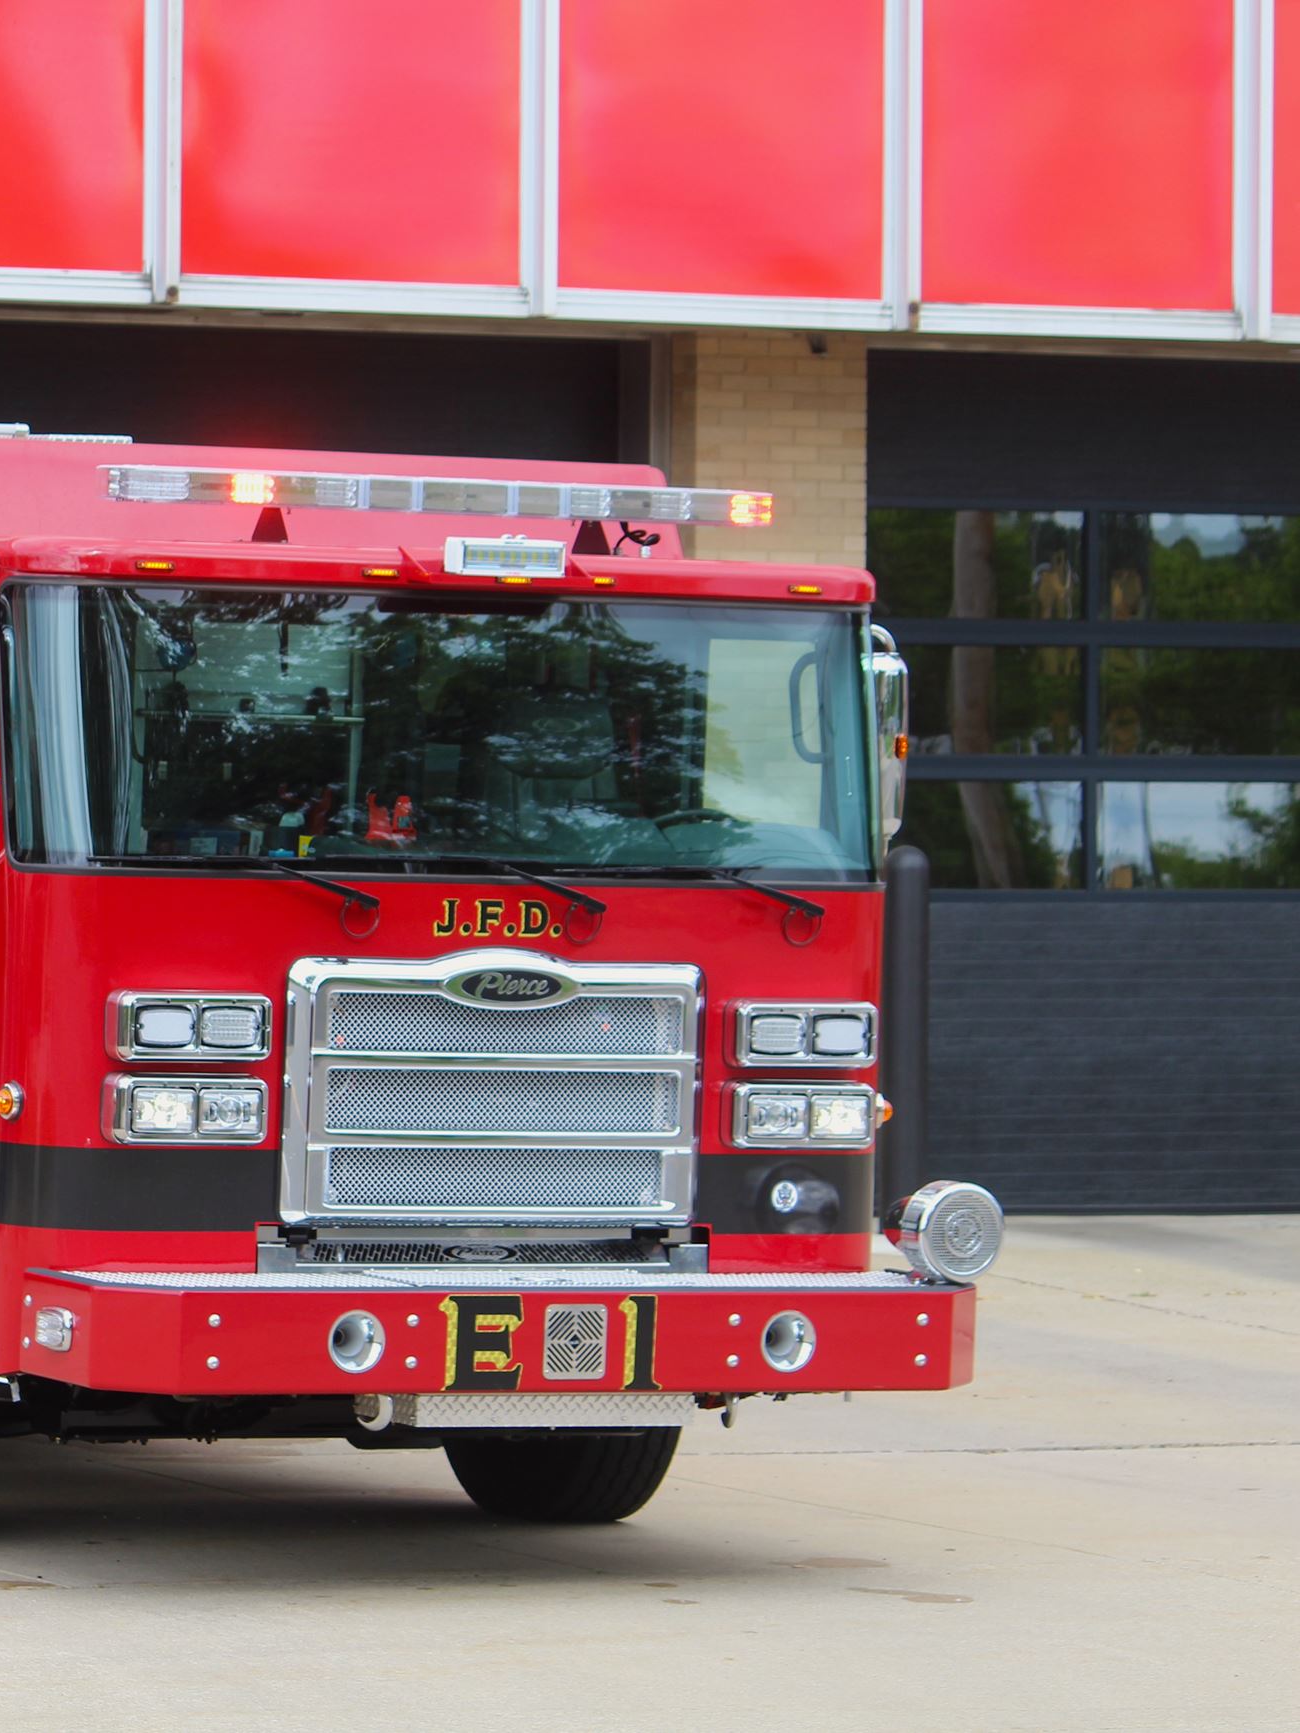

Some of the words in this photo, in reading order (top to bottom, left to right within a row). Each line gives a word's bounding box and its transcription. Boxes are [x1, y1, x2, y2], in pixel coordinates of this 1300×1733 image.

[434, 898, 563, 937] J.F.D.
[474, 971, 550, 1000] Pierce
[438, 1294, 524, 1391] E
[618, 1294, 663, 1391] 1
